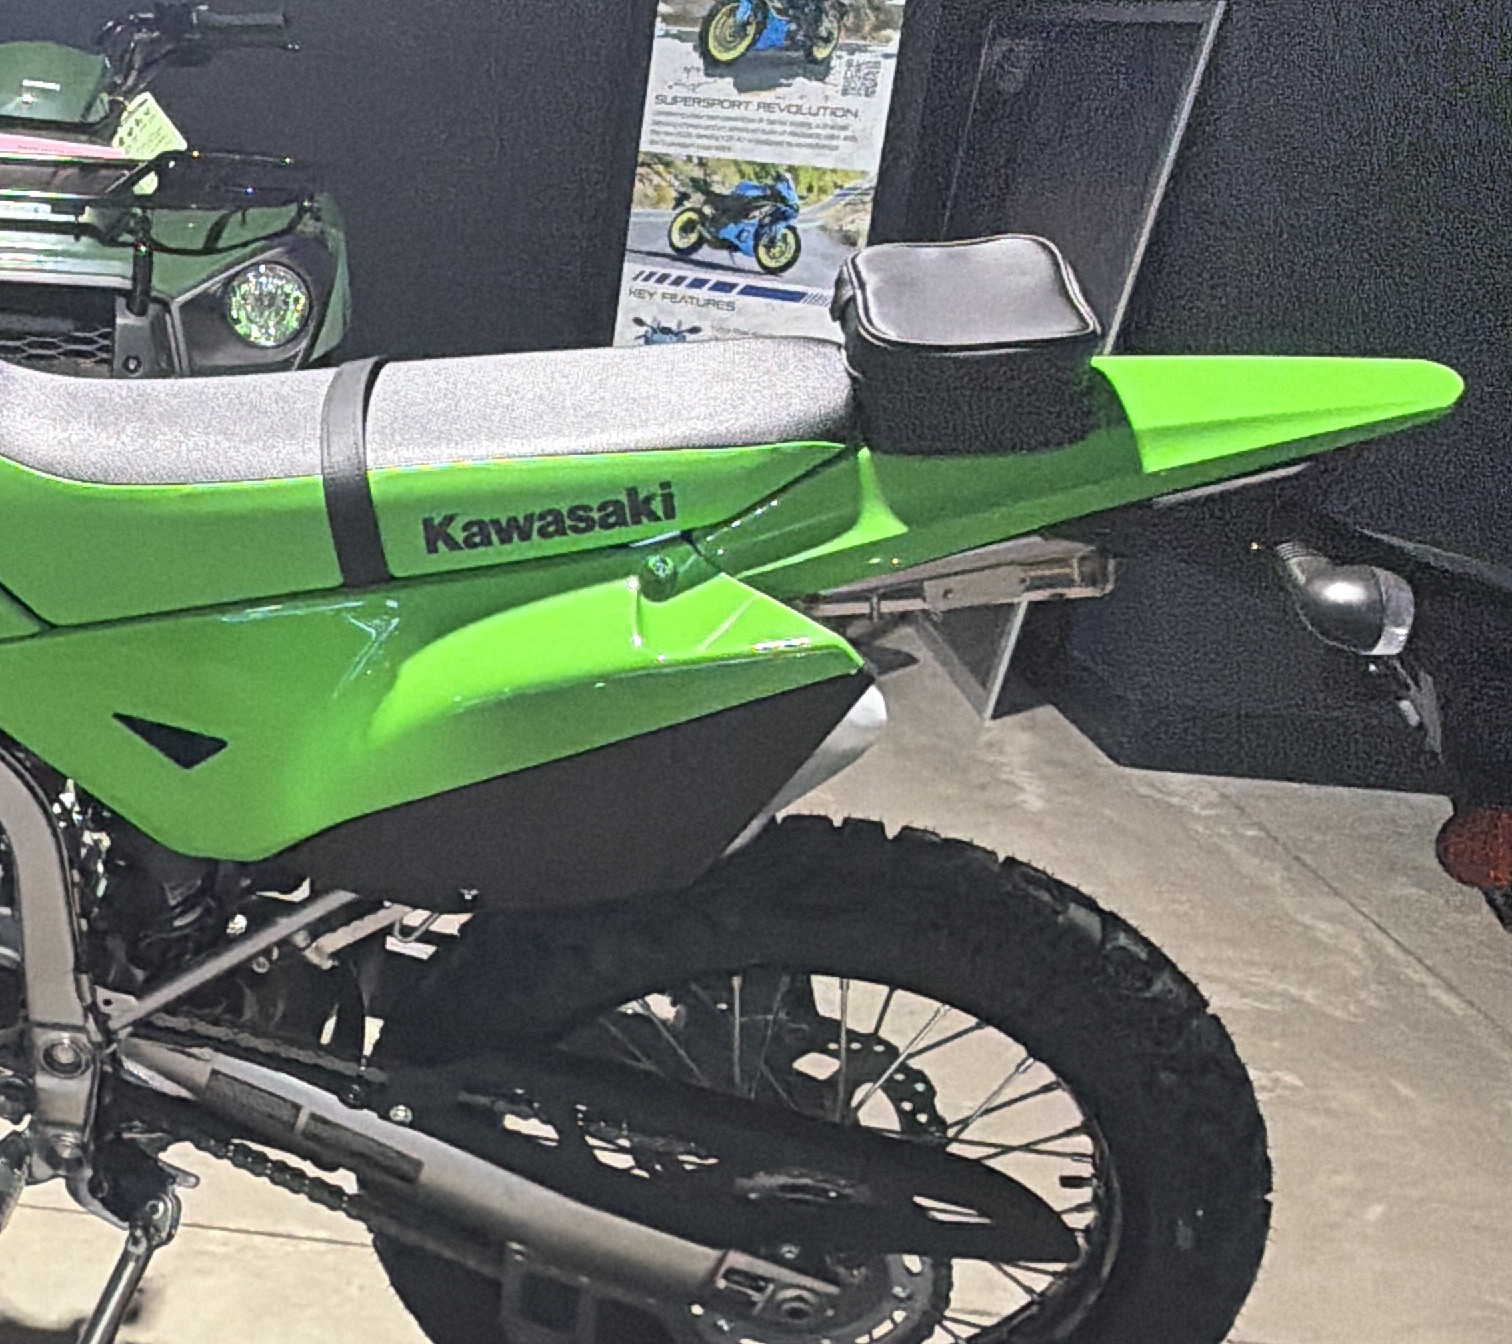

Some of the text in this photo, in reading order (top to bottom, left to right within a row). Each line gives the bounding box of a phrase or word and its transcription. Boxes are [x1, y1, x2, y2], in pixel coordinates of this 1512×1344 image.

[654, 94, 751, 111] SUPERSPORT
[628, 288, 736, 311] KEY FEATURES
[422, 480, 676, 554] Kawasaki
